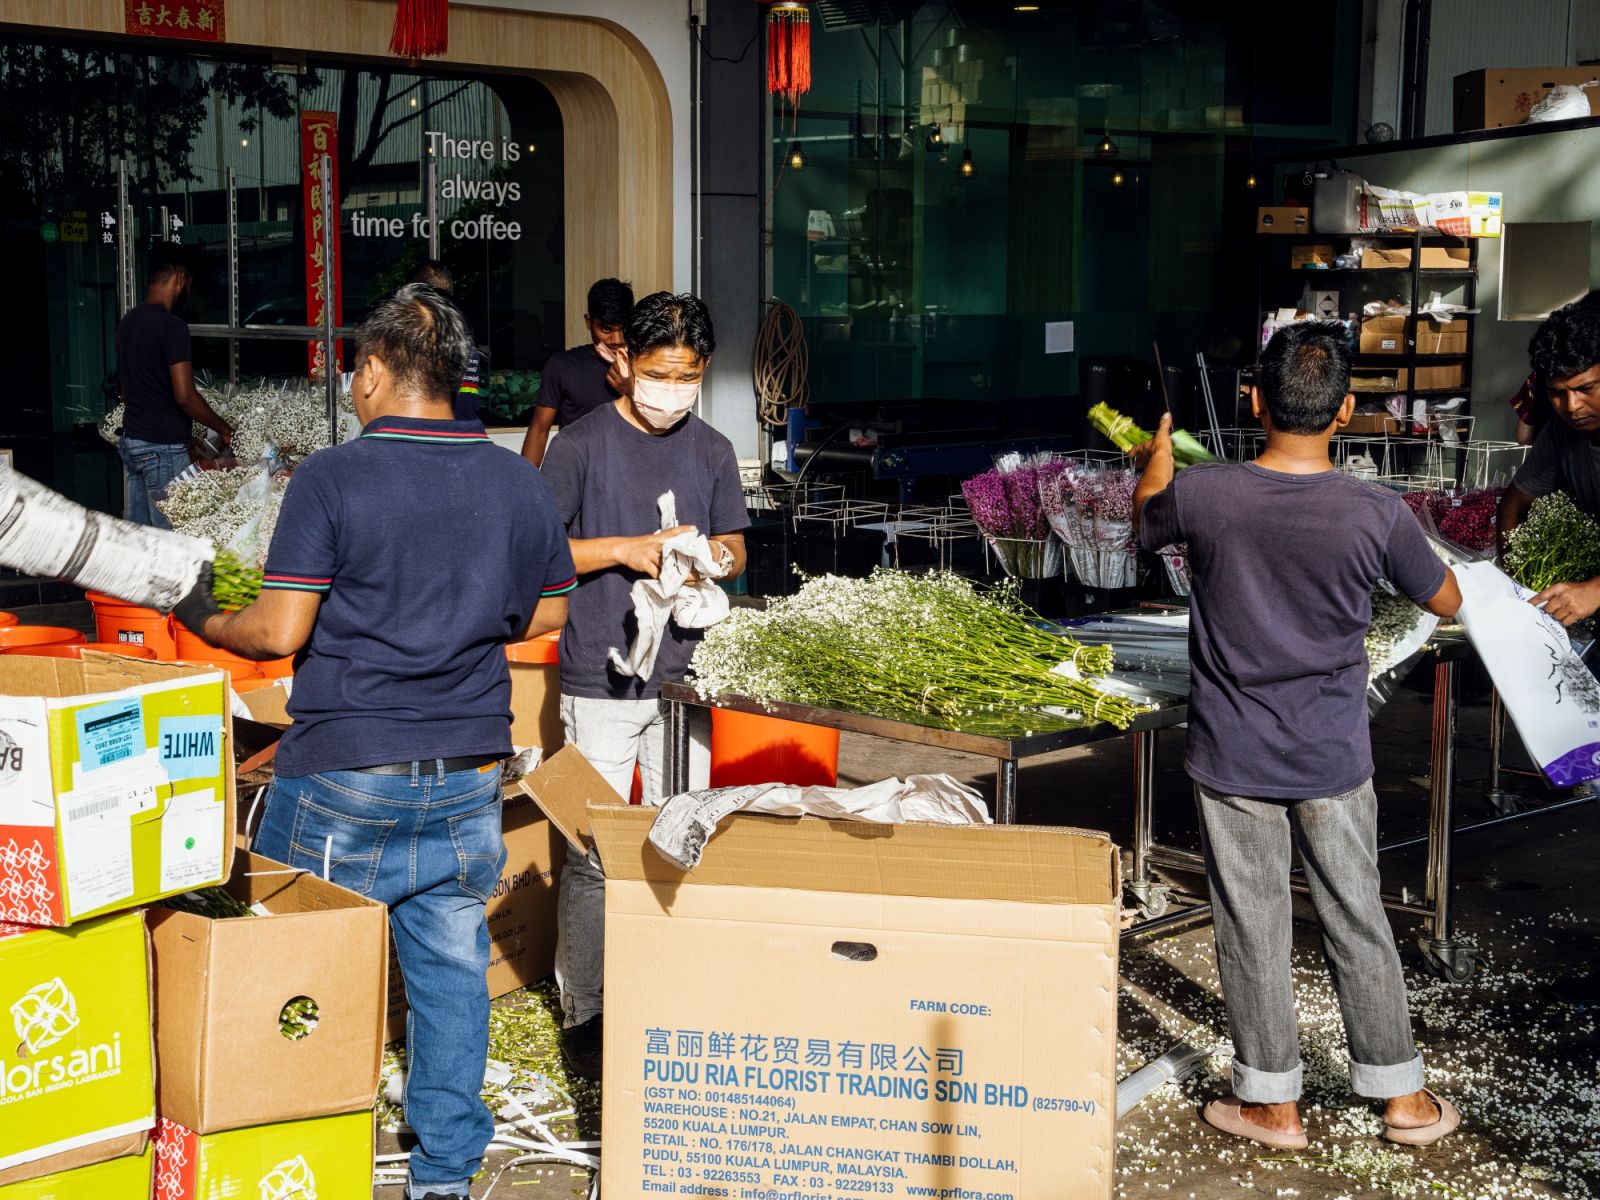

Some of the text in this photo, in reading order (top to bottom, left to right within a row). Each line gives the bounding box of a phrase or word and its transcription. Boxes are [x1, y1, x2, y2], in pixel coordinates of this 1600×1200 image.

[425, 131, 521, 161] There is
[441, 173, 521, 207] always
[351, 210, 521, 240] time for coffee
[164, 731, 214, 759] WHITE
[513, 870, 531, 891] BHD
[910, 1000, 992, 1016] FARM CODE:
[645, 1027, 963, 1076] 富丽鲜花贸易有限公司
[25, 1087, 43, 1099] SAN
[75, 1067, 121, 1085] LABRADOR
[644, 1059, 1096, 1116] PUDU RIA FLORIST TRADING SDN BHD (825790-V)
[644, 1086, 796, 1110] (GST NO: 001485144064)
[644, 1102, 728, 1118] WAREHOUSE
[739, 1109, 780, 1124] NO.21,
[784, 1112, 827, 1125] JALAN
[831, 1115, 877, 1131] EMPAT,
[879, 1119, 917, 1132] CHAN
[921, 1122, 953, 1135] SOW
[957, 1124, 981, 1138] LIN,
[644, 1117, 789, 1139] 55200 KUALA LUMPUR.
[643, 1132, 688, 1147] RETAIL
[700, 1137, 722, 1150] NO.
[726, 1139, 776, 1155] 176/178,
[779, 1144, 823, 1157] JALAN
[826, 1146, 901, 1162] CHANGKAT
[904, 1152, 955, 1167] THAMBI
[959, 1156, 1018, 1173] DOLLAH,
[643, 1148, 908, 1179] PUDU, 55100 KUALA LUMPUR, MALAYSIA.
[642, 1164, 666, 1176] TEL
[677, 1167, 692, 1178] 03
[703, 1168, 761, 1184] 92263553
[773, 1174, 799, 1187] FAX
[809, 1176, 824, 1188] 03
[835, 1178, 894, 1193] 92229133
[907, 1185, 1013, 1200] www.prflora.com
[642, 1180, 676, 1193] Email
[680, 1184, 729, 1197] address
[740, 1188, 865, 1200] info@prflorist
